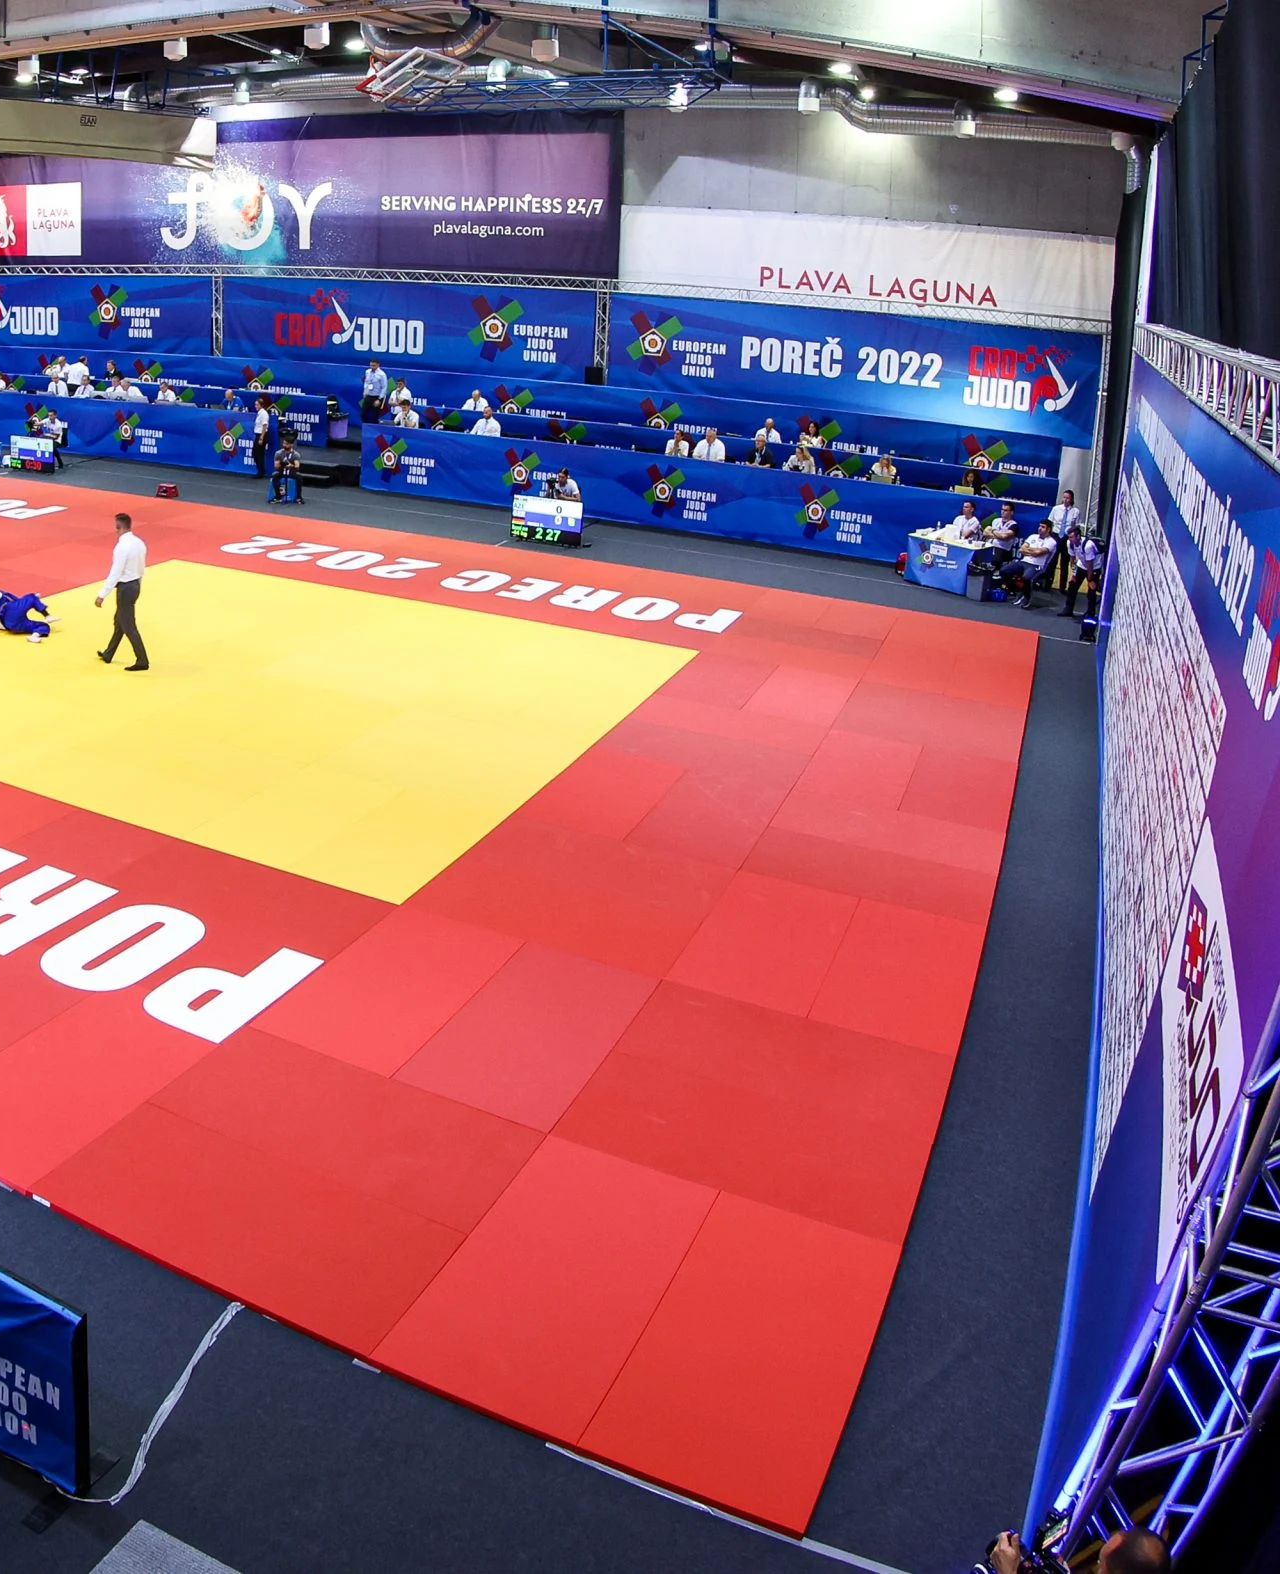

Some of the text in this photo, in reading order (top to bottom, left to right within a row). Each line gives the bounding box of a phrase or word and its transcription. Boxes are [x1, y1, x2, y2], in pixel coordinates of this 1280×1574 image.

[37, 208, 68, 217] PLAVA
[161, 172, 332, 250] JOY
[381, 194, 603, 218] SERVING HAPPINESS 24/7
[32, 220, 75, 232] LAGUNA
[433, 221, 544, 238] plavalaguna.com
[759, 266, 998, 307] PLAVA LAGUNA
[121, 307, 160, 318] EUROPEAN
[10, 306, 59, 336] JUDO
[130, 318, 150, 328] JUDO
[128, 328, 153, 338] UNION
[274, 313, 424, 355] CRO JUDO
[513, 324, 568, 339] EUROPEAN
[526, 338, 553, 350] JUDO
[672, 339, 727, 356] EUROPEAN
[523, 350, 556, 363] UNION
[685, 353, 712, 366] JUDO
[740, 335, 944, 390] POREČ 2022
[968, 345, 1017, 379] CRO
[681, 364, 715, 379] UNION
[963, 375, 1032, 412] JUDO
[285, 412, 320, 423] EUROPEAN
[135, 428, 163, 438] EUROPEAN
[401, 456, 435, 468] EUROPEAN
[408, 466, 426, 476] JUDO
[407, 475, 428, 486] UNION
[676, 488, 717, 502] EUROPEAN
[686, 500, 705, 511] JUDO
[683, 510, 708, 522] UNION
[830, 509, 873, 525] EUROPEAN
[840, 521, 861, 533] JUDO
[836, 531, 862, 544] UNION
[1199, 485, 1232, 587] POREČ
[1220, 519, 1255, 637] 2022
[220, 535, 743, 634] POREC 2022
[1242, 612, 1273, 711] JUDO
